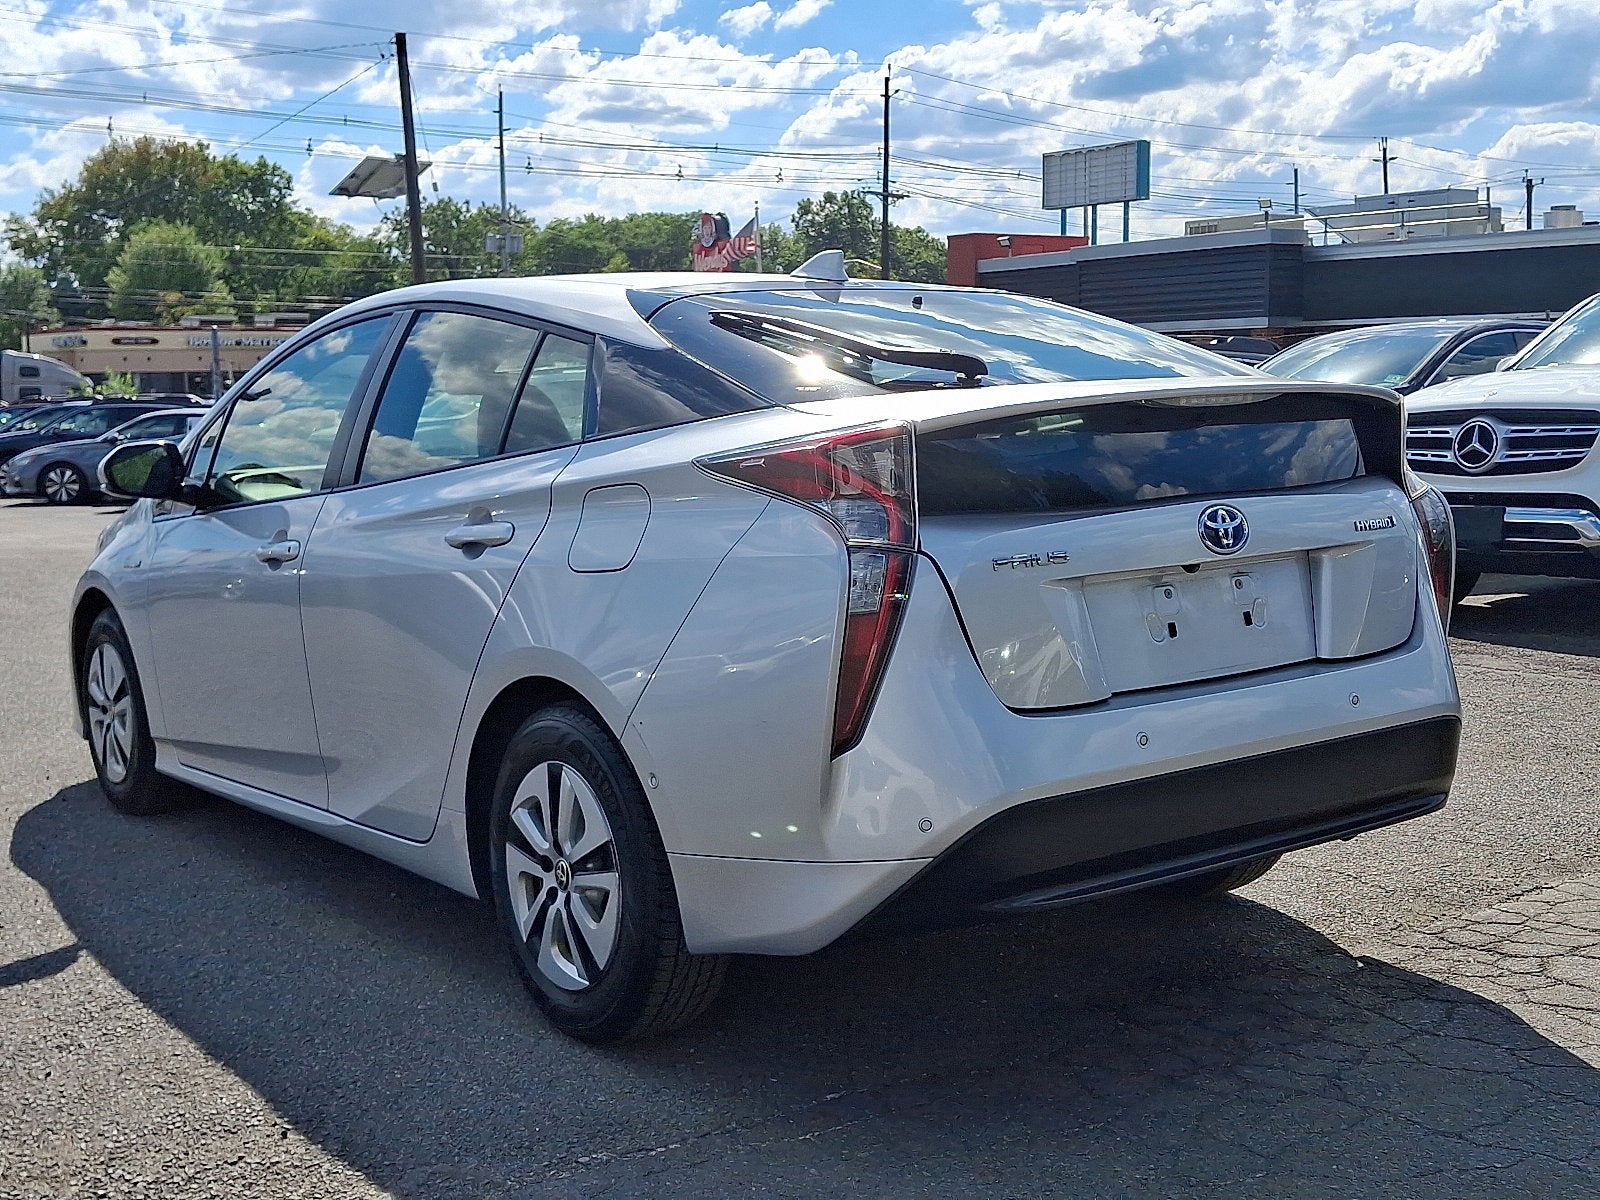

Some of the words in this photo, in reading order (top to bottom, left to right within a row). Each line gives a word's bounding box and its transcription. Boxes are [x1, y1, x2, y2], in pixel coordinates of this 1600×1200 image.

[187, 335, 236, 346] Boson
[1356, 517, 1392, 532] HYBRID
[992, 551, 1070, 571] PRIUS
